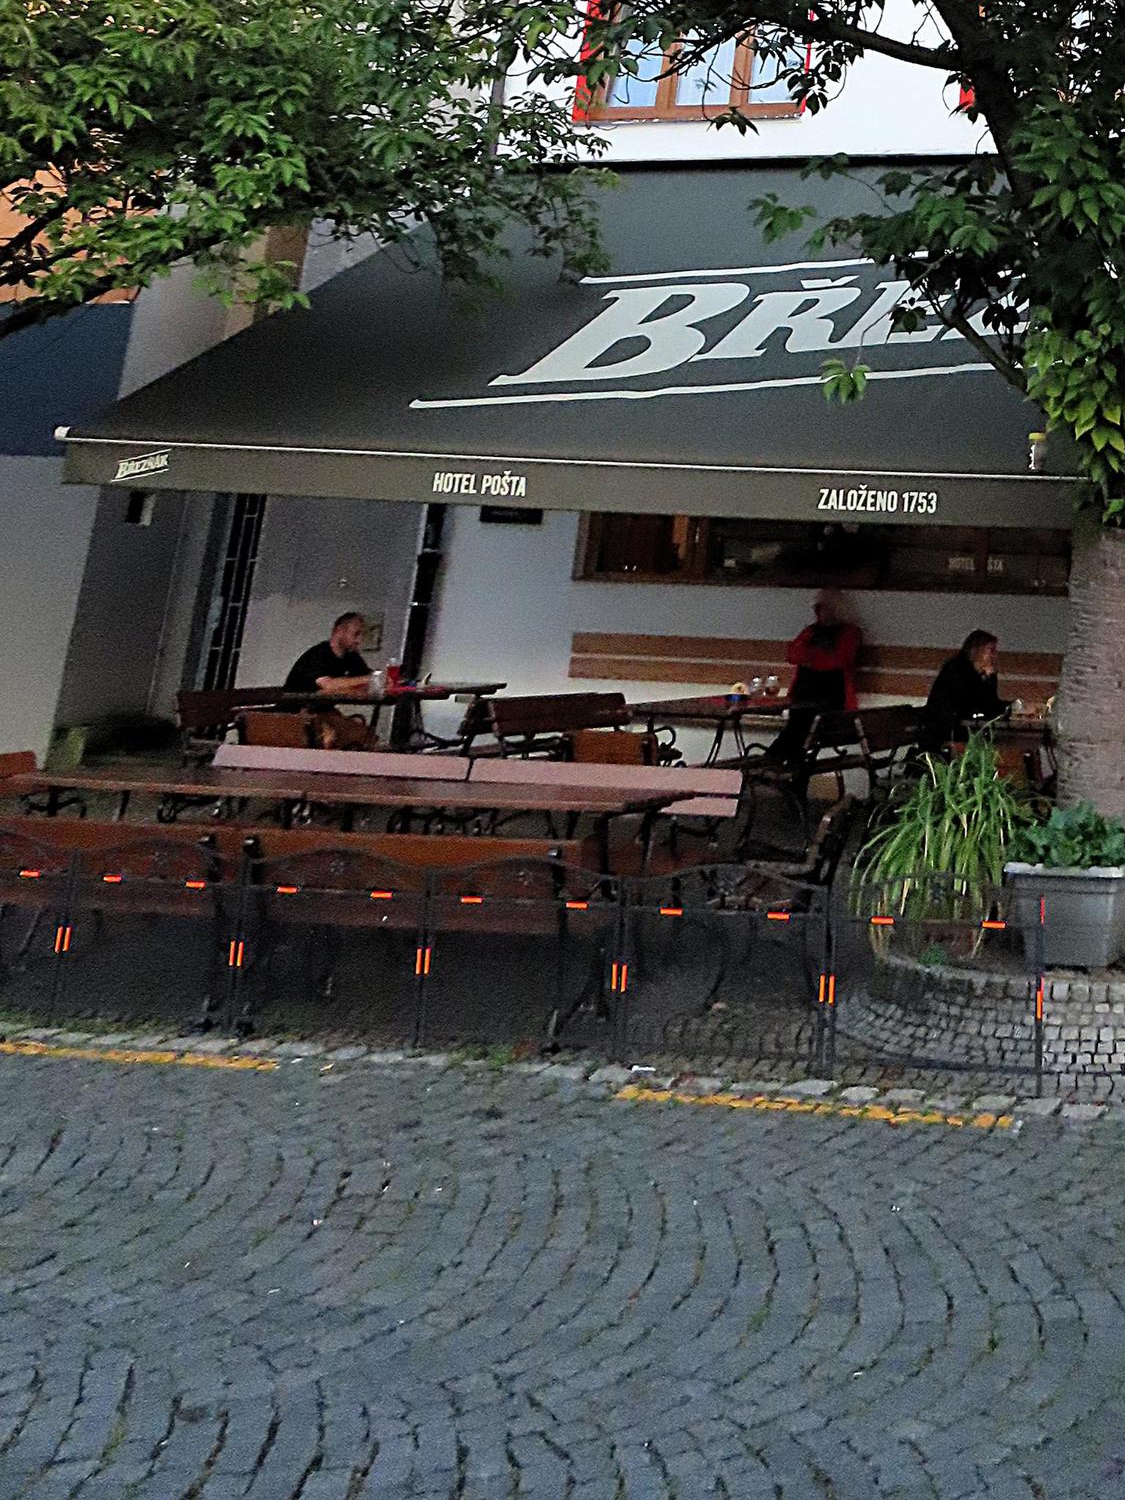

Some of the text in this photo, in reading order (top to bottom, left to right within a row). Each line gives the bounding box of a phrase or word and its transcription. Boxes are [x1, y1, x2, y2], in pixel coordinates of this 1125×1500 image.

[433, 470, 526, 496] HOTEL POŠTA
[818, 484, 937, 513] ZALOŽENO 1753
